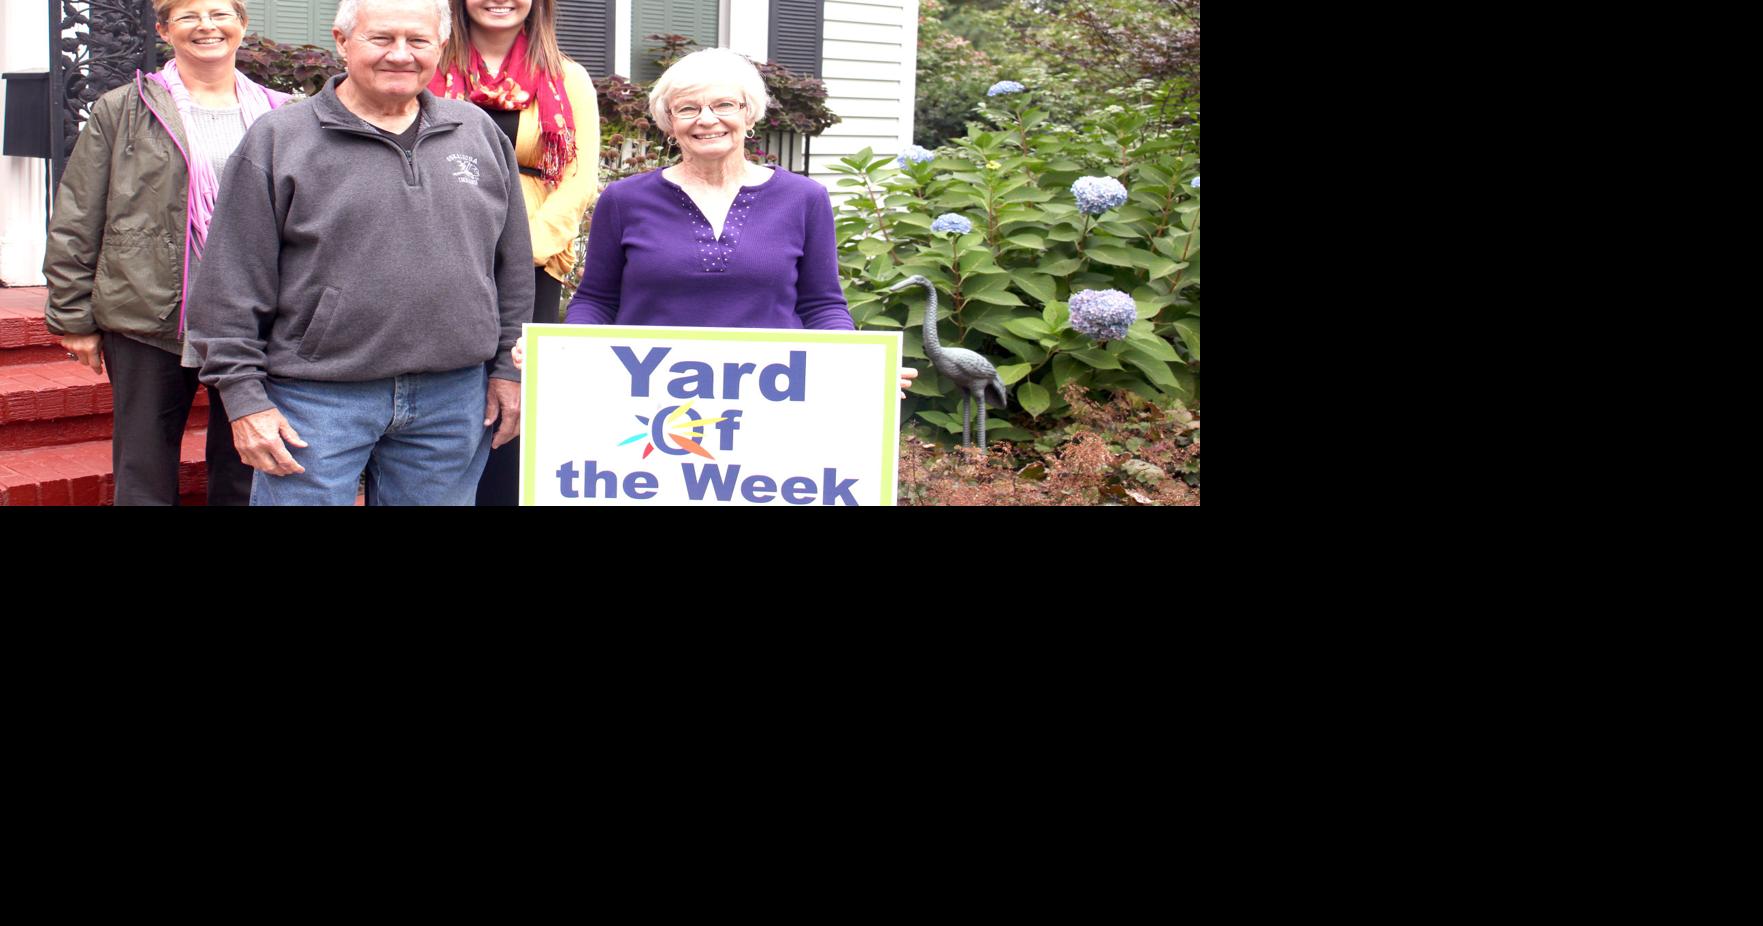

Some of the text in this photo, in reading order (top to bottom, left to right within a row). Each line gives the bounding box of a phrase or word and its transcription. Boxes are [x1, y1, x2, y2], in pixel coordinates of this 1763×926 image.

[611, 345, 807, 402] Yard
[651, 405, 743, 456] Of
[555, 460, 859, 506] the Week
